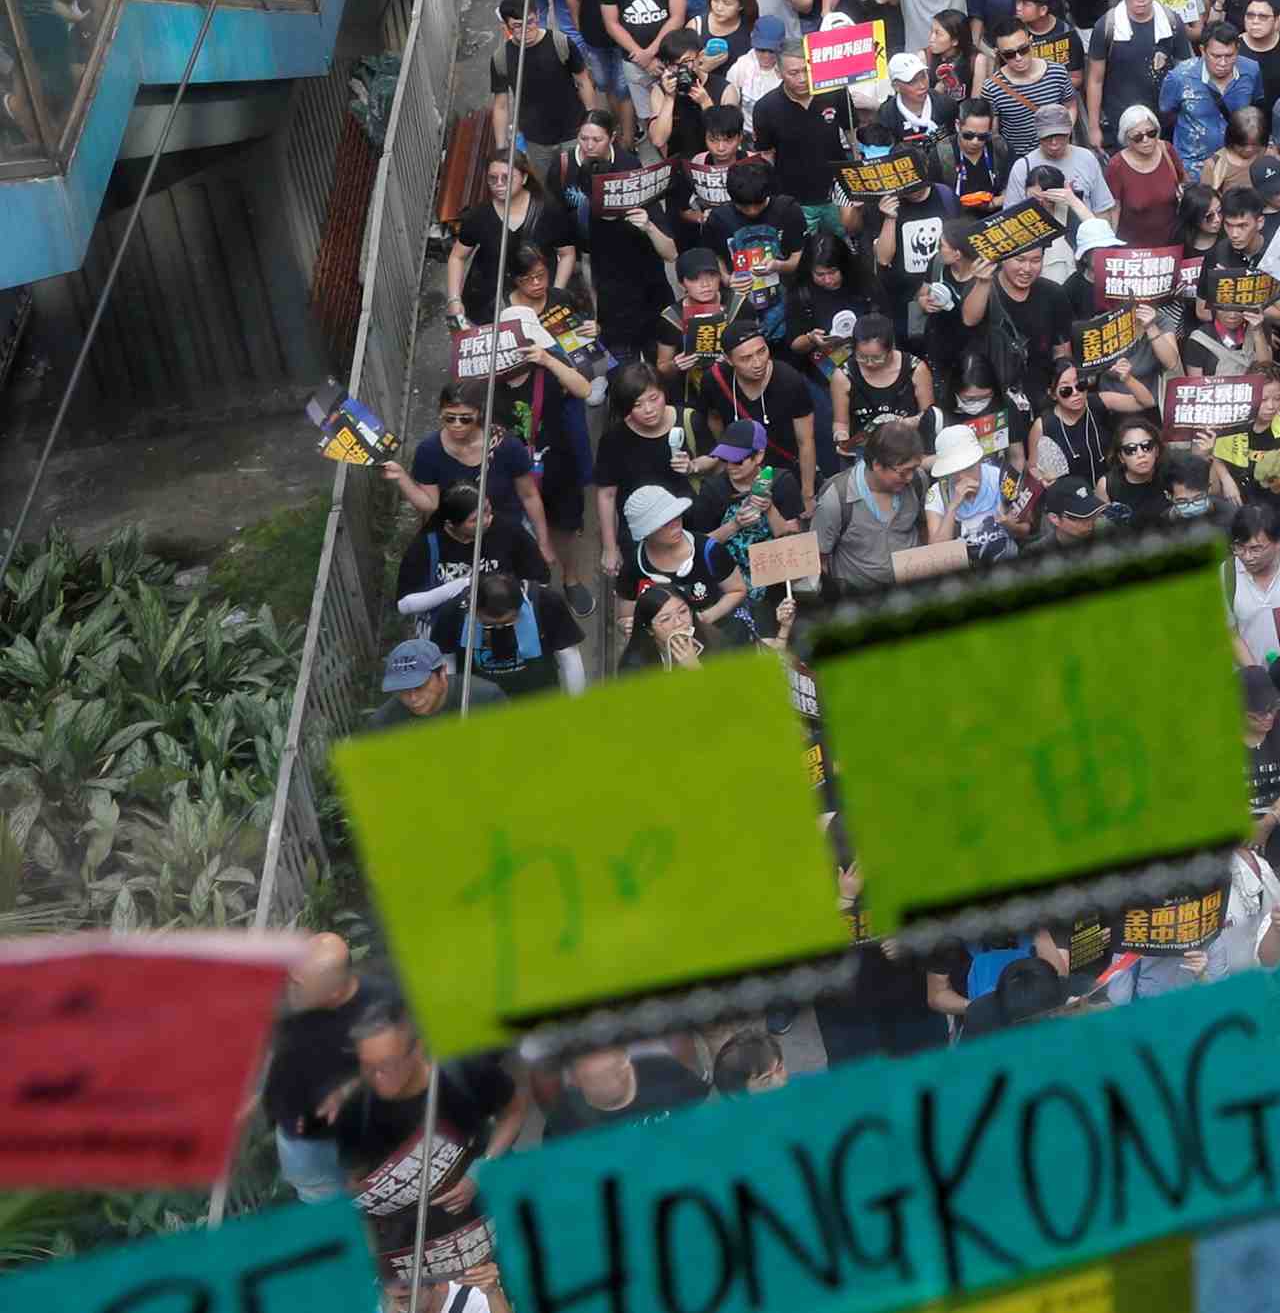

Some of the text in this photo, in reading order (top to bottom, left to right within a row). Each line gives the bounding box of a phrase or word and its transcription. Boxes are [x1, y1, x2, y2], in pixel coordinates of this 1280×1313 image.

[840, 156, 915, 180] 全面撤回
[1105, 256, 1176, 277] 平反暴動
[1175, 383, 1254, 404] 平反暴動
[1173, 403, 1252, 425] 撤銷檢控
[1124, 890, 1222, 927] 全面撤回
[1123, 911, 1220, 943] 送中惡法
